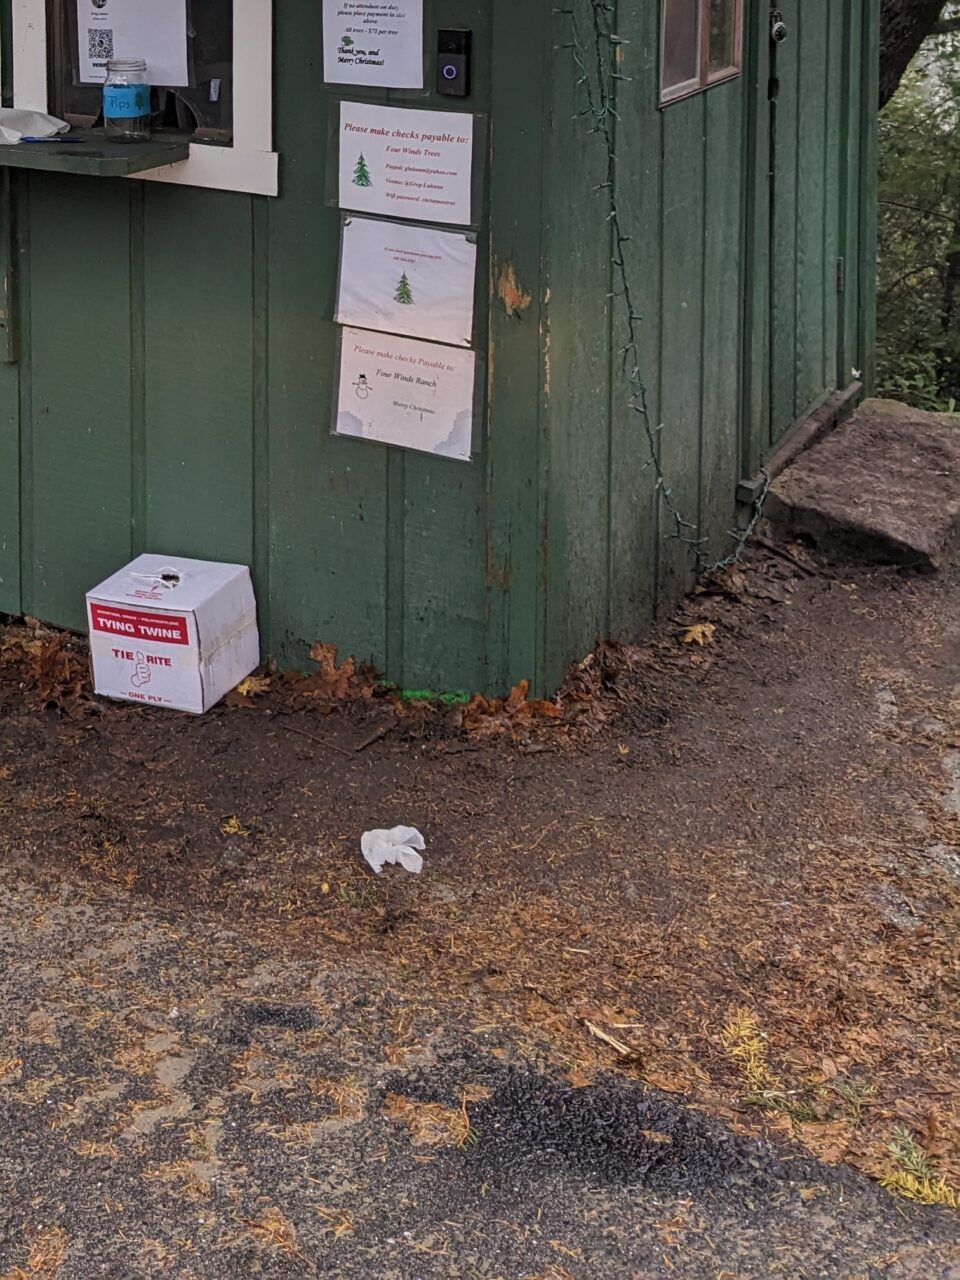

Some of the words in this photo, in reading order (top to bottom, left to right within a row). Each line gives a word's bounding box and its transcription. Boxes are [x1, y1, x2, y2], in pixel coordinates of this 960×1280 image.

[337, 57, 354, 65] Merry
[108, 96, 130, 112] Tips
[344, 123, 368, 134] Please
[370, 128, 390, 137] make
[392, 129, 419, 139] checks
[421, 133, 455, 143] payable
[402, 147, 422, 155] Winds
[424, 149, 441, 157] Trees
[354, 344, 376, 356] Please
[376, 350, 394, 360] make
[394, 354, 416, 364] checks
[418, 357, 445, 369] Payable
[376, 368, 392, 378] Four
[393, 373, 414, 382] Winds
[416, 377, 437, 387] Ranch
[392, 400, 408, 410] Merry
[409, 404, 435, 414] Christmas
[98, 618, 135, 632] TYING
[138, 625, 182, 640] TWINE
[112, 648, 134, 660] TIE
[146, 655, 172, 666] RITE
[128, 692, 145, 700] ONE
